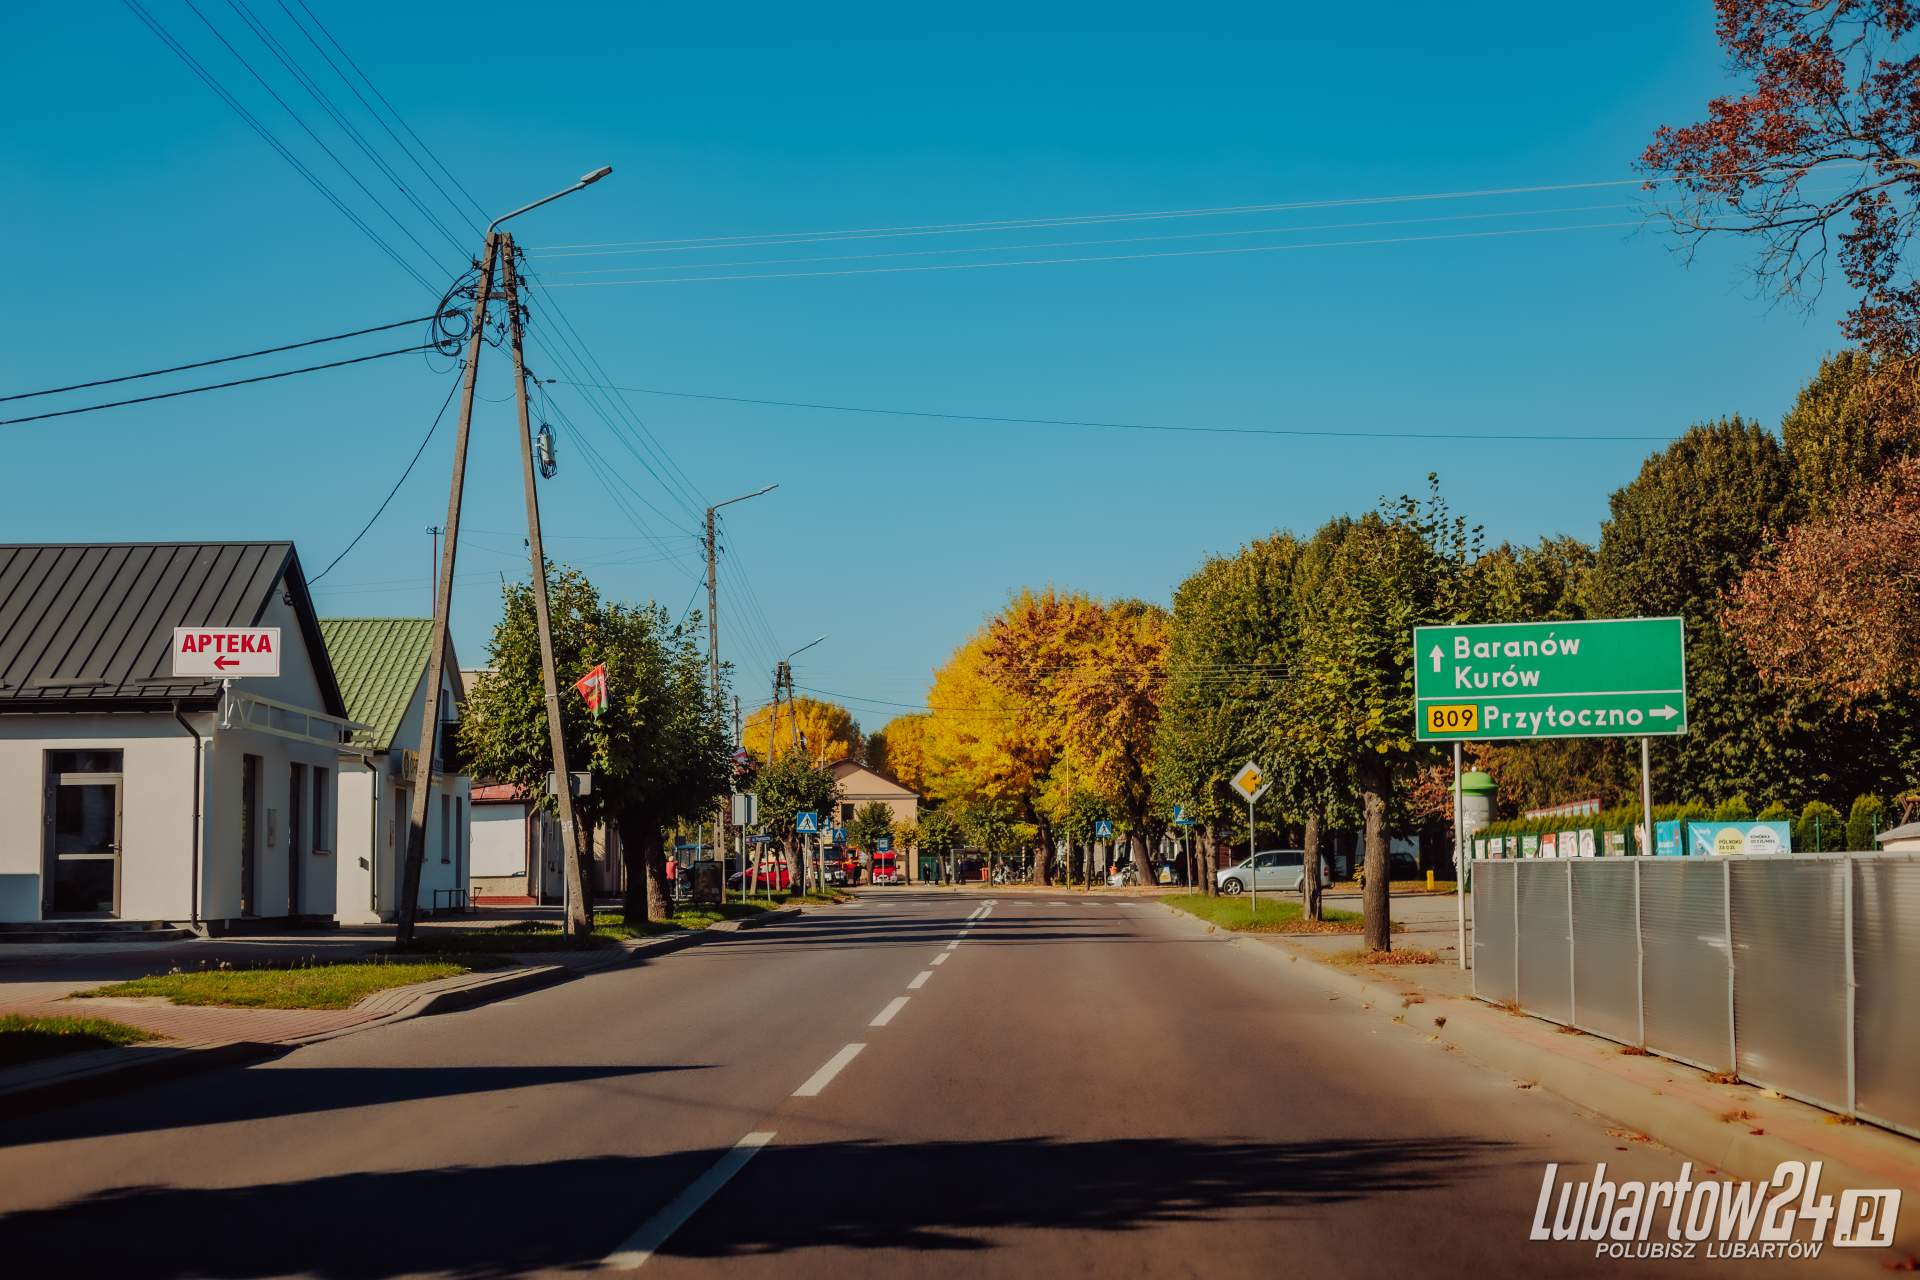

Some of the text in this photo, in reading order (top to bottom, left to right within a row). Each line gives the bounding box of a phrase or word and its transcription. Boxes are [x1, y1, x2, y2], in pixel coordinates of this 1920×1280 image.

[181, 634, 272, 653] APTEKA
[1454, 632, 1580, 660] Baranów
[1455, 664, 1540, 689] Kurów
[1433, 704, 1643, 735] 809 Przytoczno
